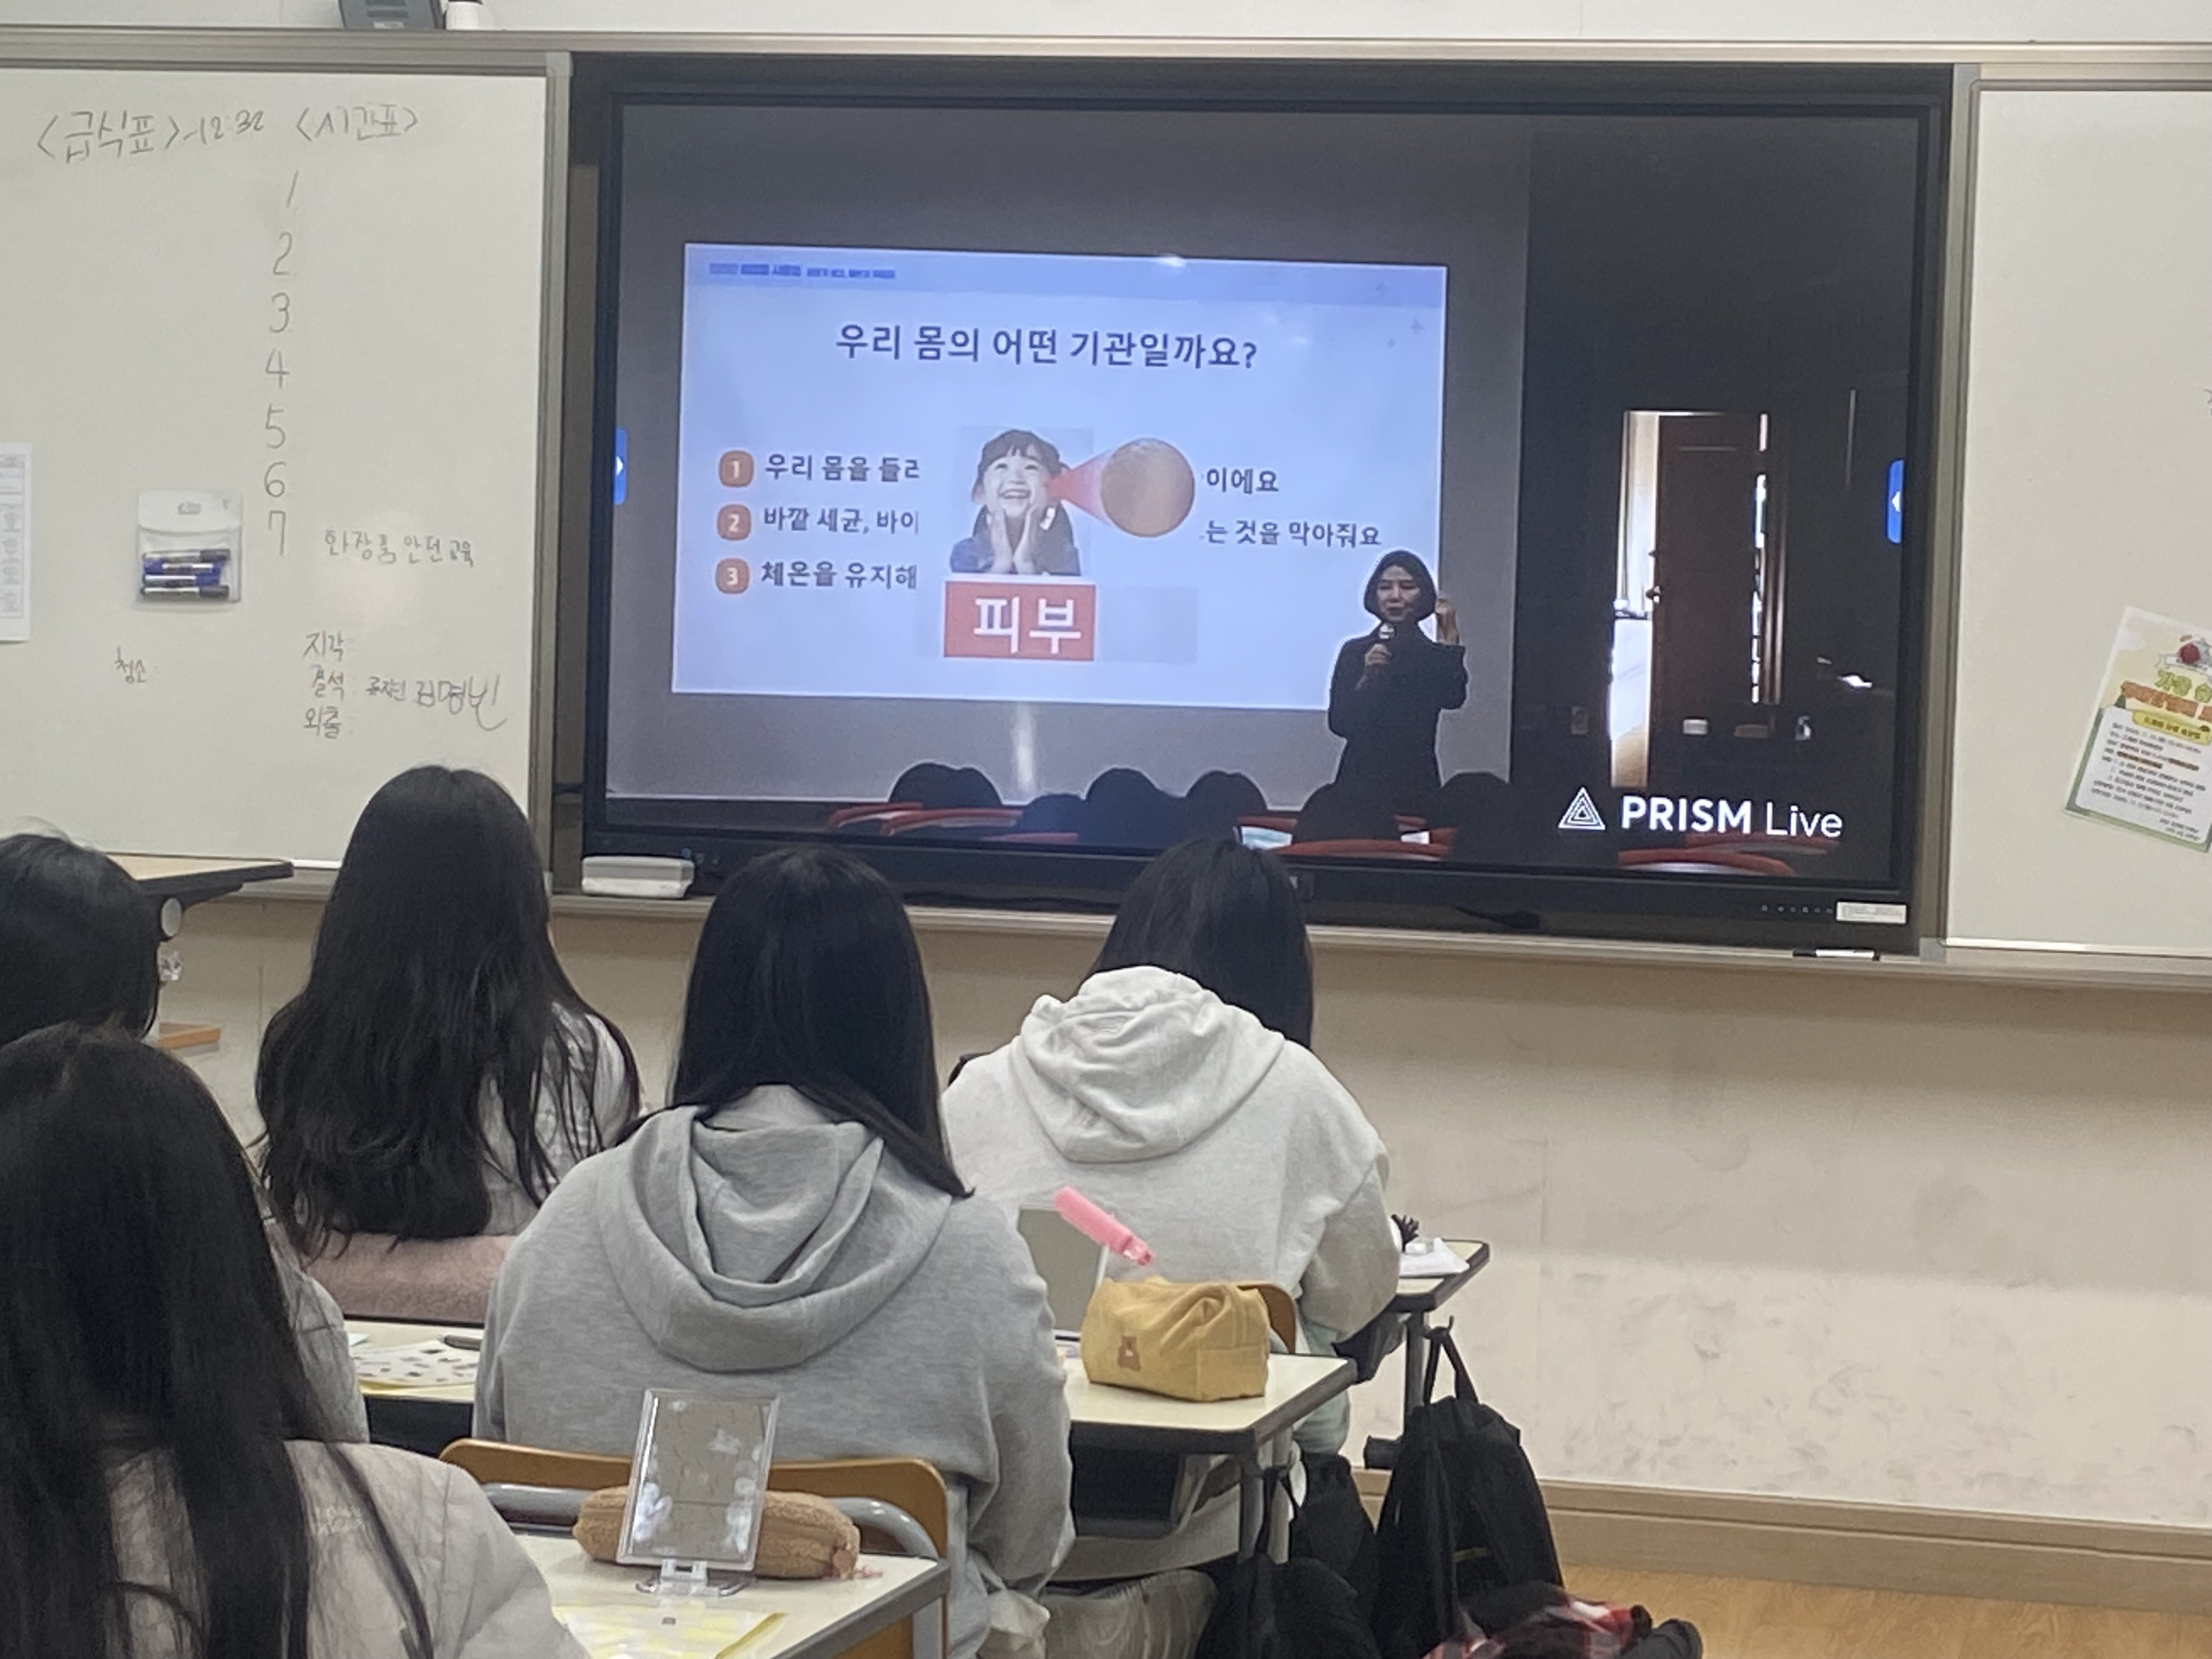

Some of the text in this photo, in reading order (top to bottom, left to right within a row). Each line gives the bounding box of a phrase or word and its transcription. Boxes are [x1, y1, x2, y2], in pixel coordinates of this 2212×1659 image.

[272, 231, 293, 276] 2
[269, 291, 290, 334] 3
[264, 348, 290, 389] 4
[835, 324, 1257, 370] 우리 몸의 어떤 기관일까요?
[264, 403, 286, 449] 5
[263, 460, 286, 498] 6
[764, 453, 812, 481] 우리
[821, 455, 871, 482] 몸을
[268, 509, 287, 556] 7
[764, 506, 810, 532] 바깥
[816, 507, 869, 534] 세균,
[1235, 520, 1280, 545] 것을
[1288, 521, 1381, 549] 막아줘요
[760, 560, 837, 587] 체온을
[844, 562, 917, 590] 유지해
[973, 596, 1082, 655] 피부
[1621, 795, 1843, 838] PRISM Live
